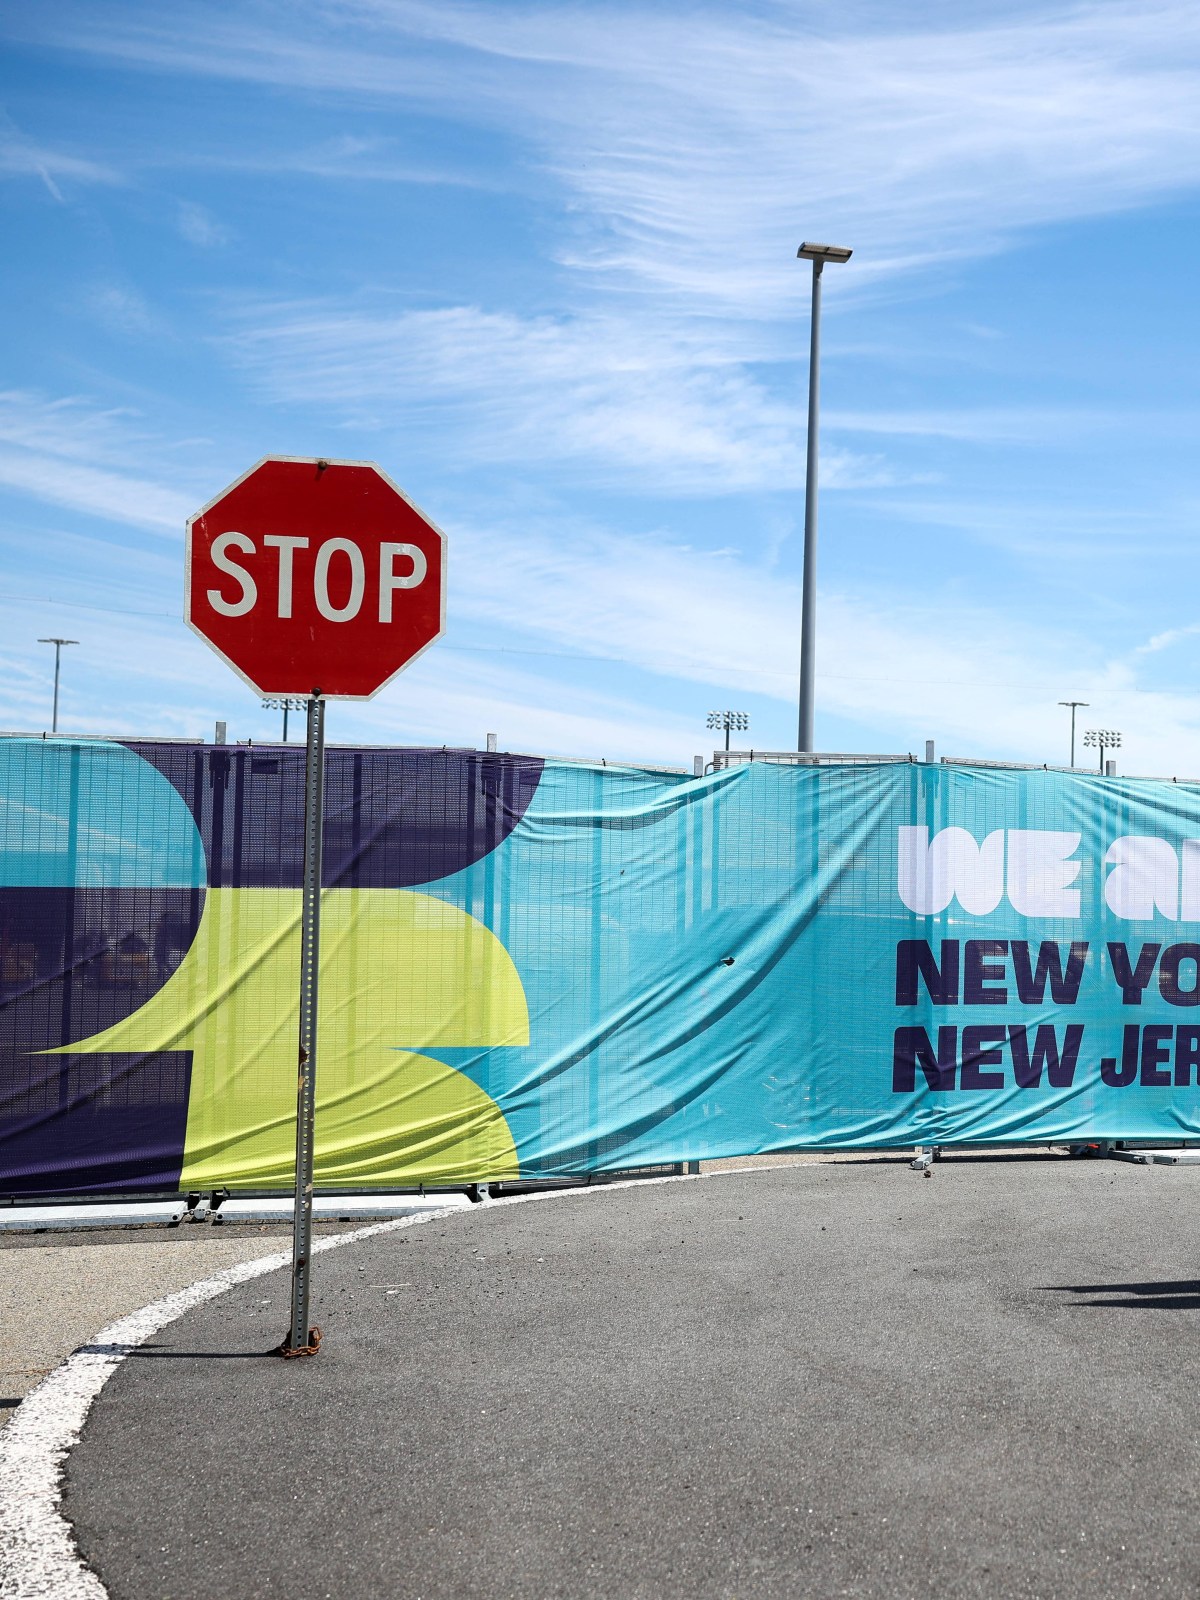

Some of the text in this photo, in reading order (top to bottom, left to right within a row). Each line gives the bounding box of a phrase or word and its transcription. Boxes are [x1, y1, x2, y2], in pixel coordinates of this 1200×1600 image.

[207, 531, 428, 623] STOP
[898, 825, 1082, 918] WE
[895, 939, 1089, 1006] NEW
[892, 1023, 1085, 1093] NEW
